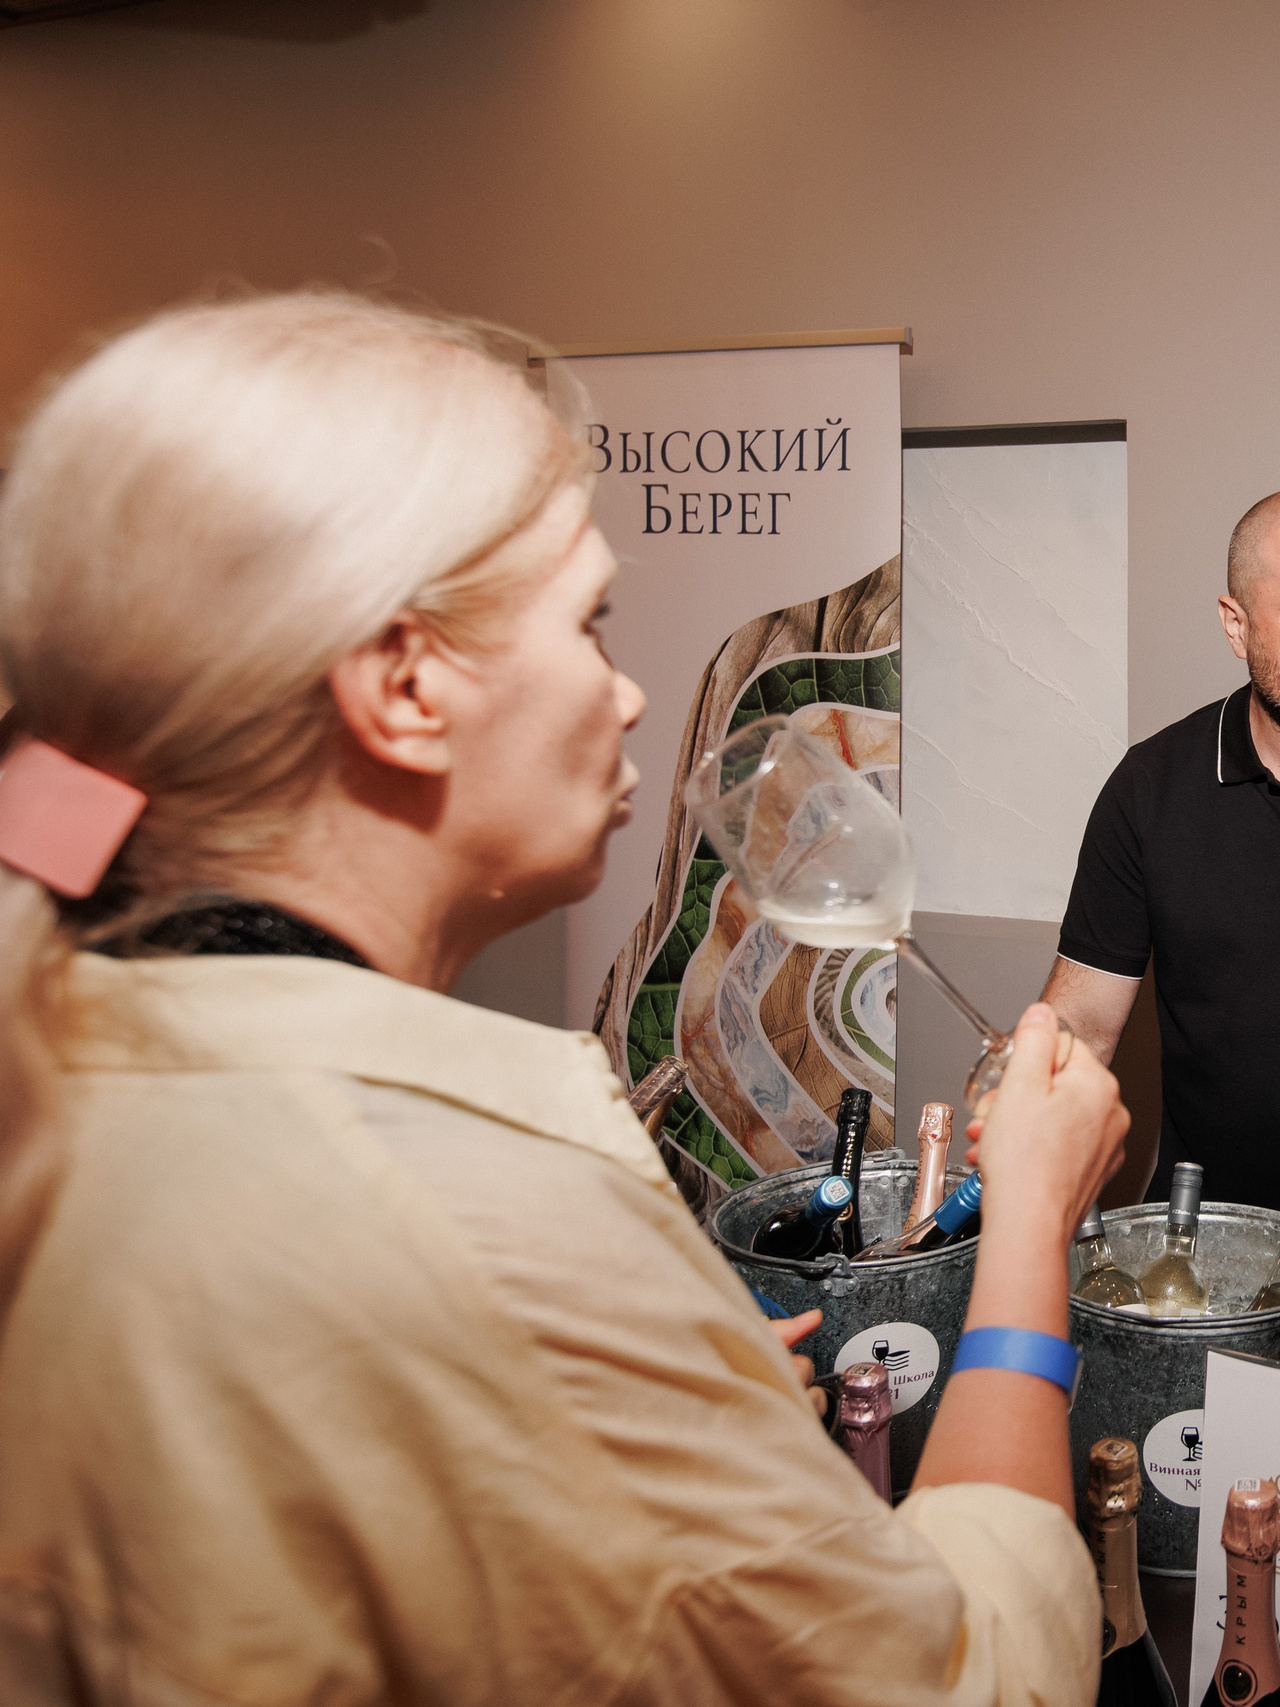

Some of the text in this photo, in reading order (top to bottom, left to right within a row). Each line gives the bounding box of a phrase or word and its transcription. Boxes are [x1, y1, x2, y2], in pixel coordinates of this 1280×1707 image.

[584, 417, 851, 473] Высокий
[641, 483, 791, 535] Берег
[893, 1370, 934, 1385] Школа
[1149, 1462, 1201, 1476] Винная
[1236, 1573, 1247, 1646] КРЫМ
